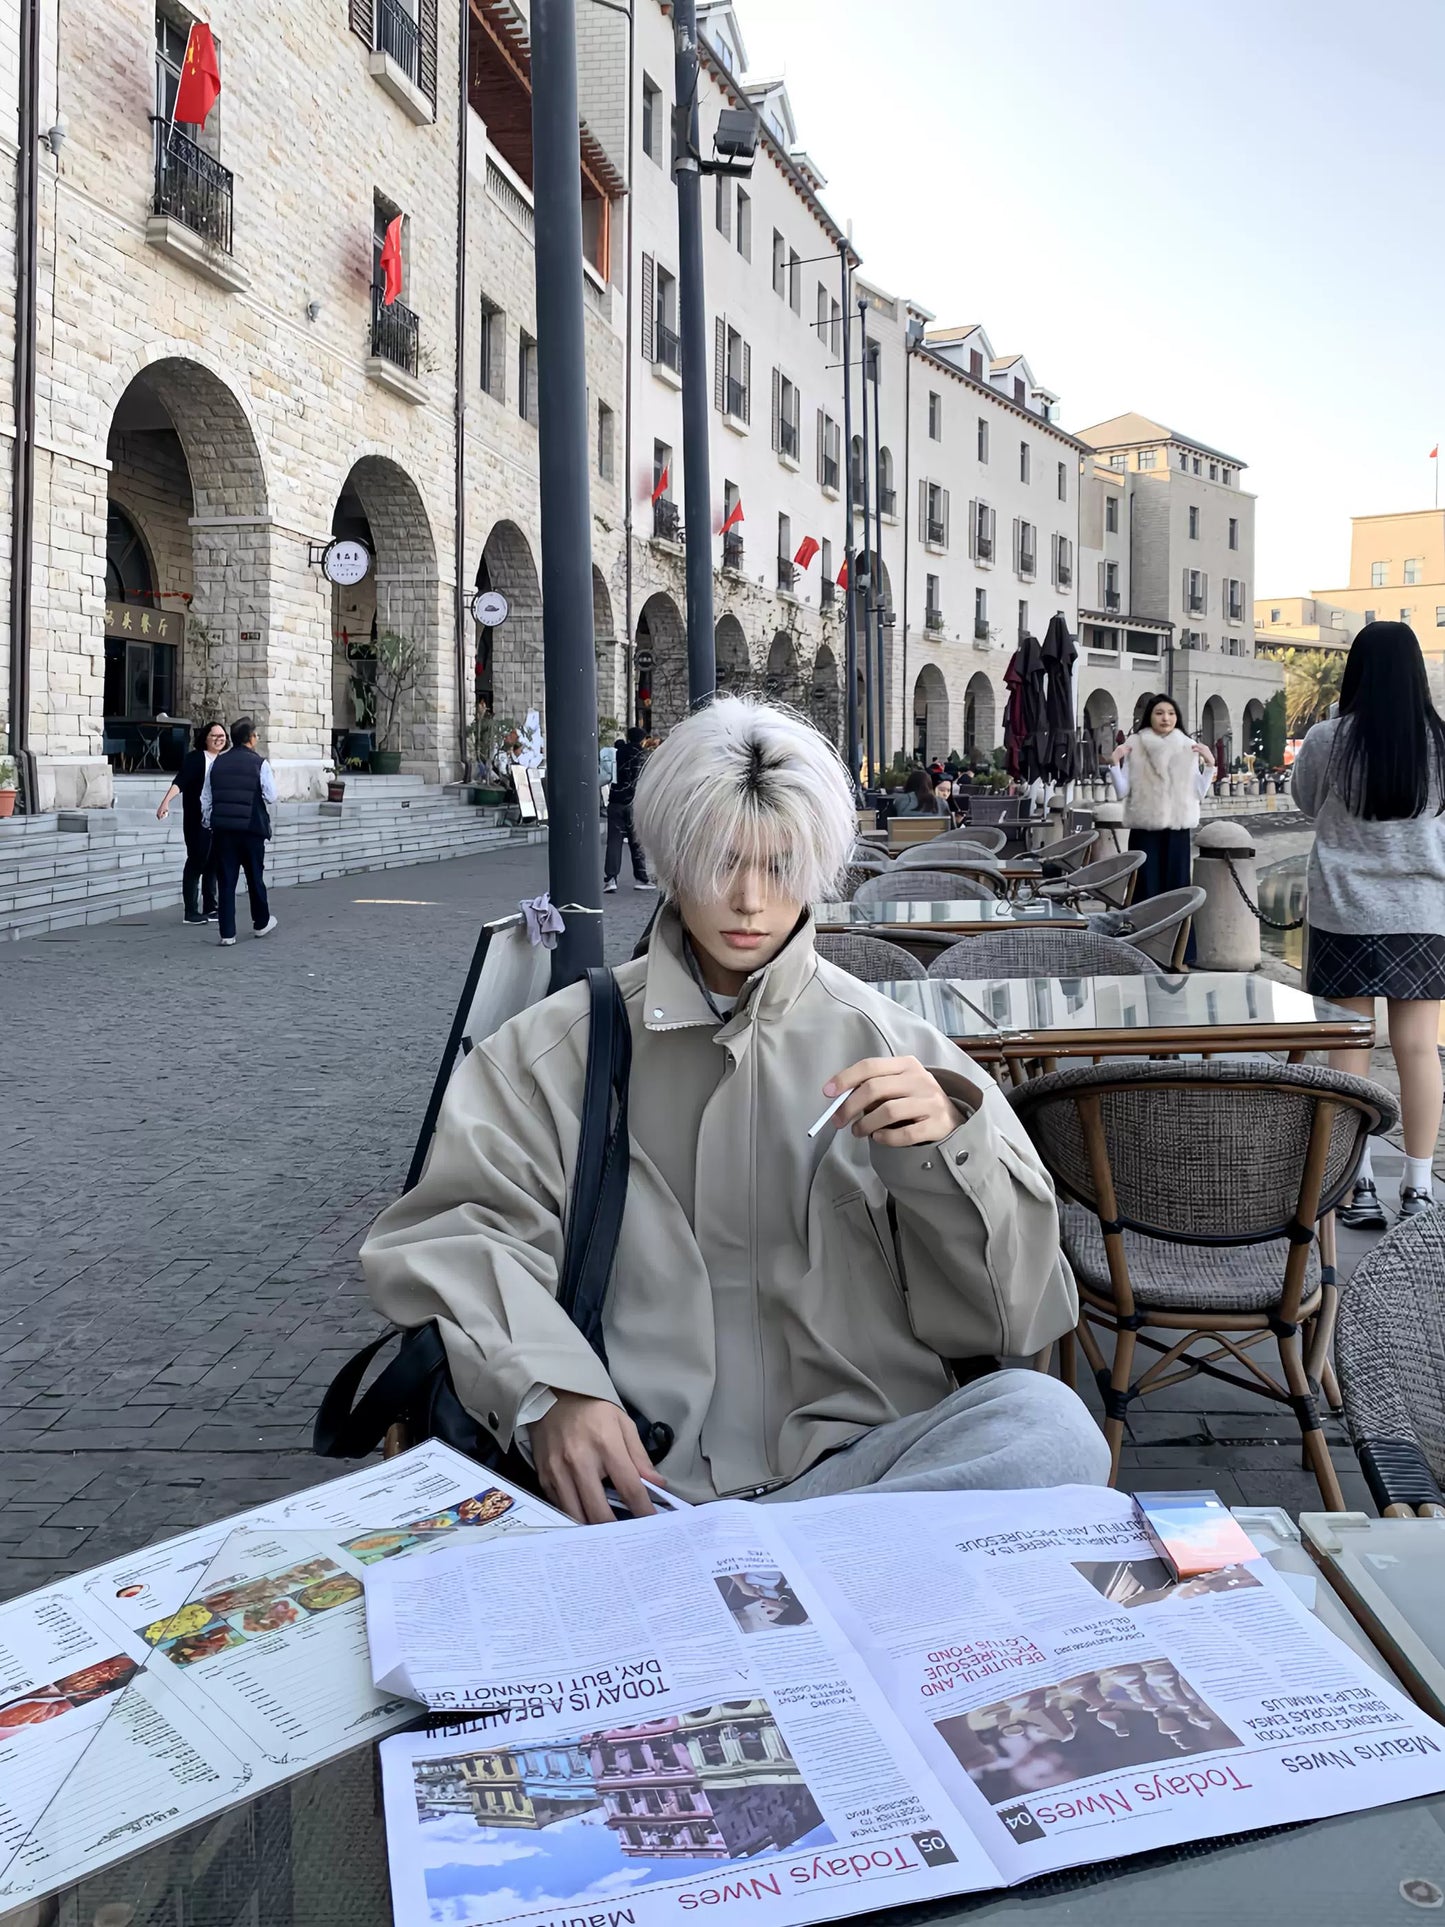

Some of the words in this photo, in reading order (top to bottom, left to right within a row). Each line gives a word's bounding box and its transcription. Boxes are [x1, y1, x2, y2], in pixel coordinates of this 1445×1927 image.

[955, 1529, 1055, 1554] PICTURESQUE
[983, 1547, 998, 1558] A
[998, 1544, 1014, 1556] IS
[1016, 1537, 1063, 1553] THERE
[926, 1643, 973, 1664] POND
[974, 1635, 1028, 1651] LOTUS
[614, 1659, 661, 1681] DAY,
[922, 1641, 1039, 1680] PICTURESQUE
[956, 1652, 1046, 1684] BEAUTIFUL
[557, 1681, 564, 1694] I
[563, 1670, 612, 1692] BUT
[918, 1676, 955, 1698] AND
[458, 1683, 554, 1702] CANNOT
[569, 1692, 591, 1712] IS
[596, 1676, 670, 1709] TODAY
[547, 1697, 563, 1715] A
[1334, 1712, 1405, 1731] HEADING
[1354, 1734, 1442, 1762] Mauris
[1280, 1748, 1357, 1776] Nwes
[1133, 1765, 1253, 1803] Todays
[1035, 1788, 1133, 1826] Nwes
[1004, 1809, 1034, 1831] 04
[917, 1835, 947, 1850] 05
[789, 1846, 920, 1884] Todays
[677, 1872, 781, 1911] Nwes
